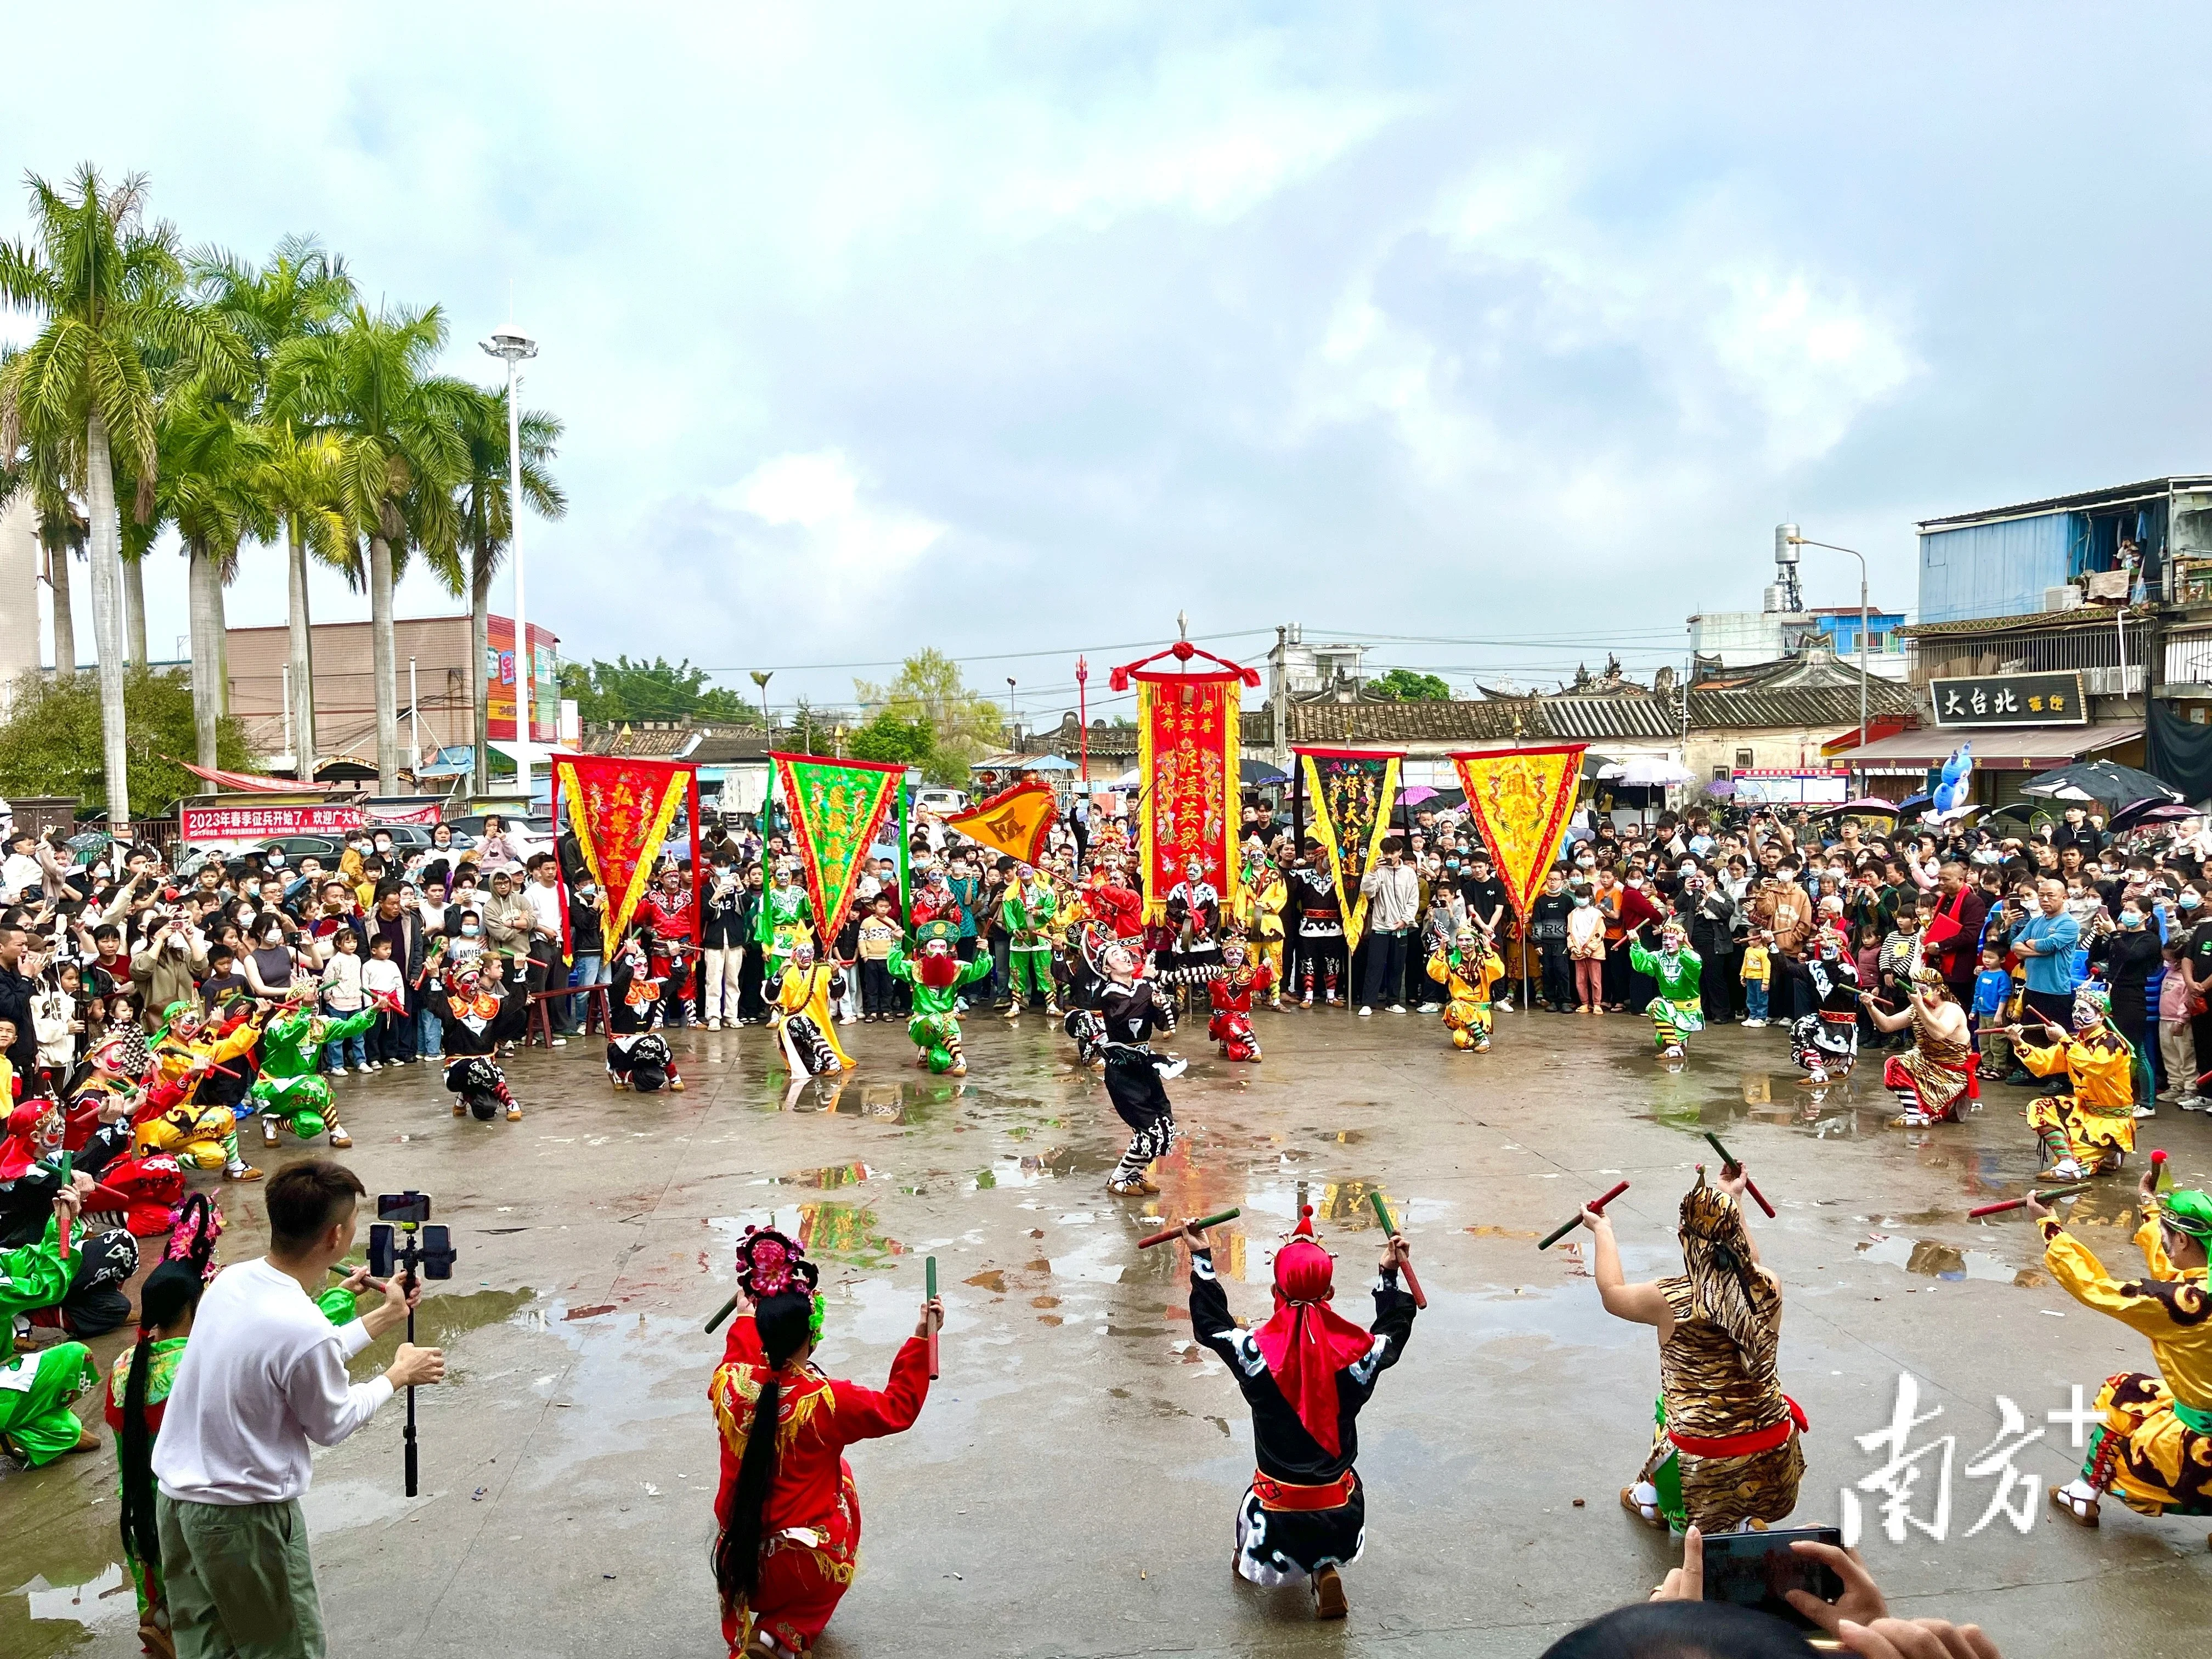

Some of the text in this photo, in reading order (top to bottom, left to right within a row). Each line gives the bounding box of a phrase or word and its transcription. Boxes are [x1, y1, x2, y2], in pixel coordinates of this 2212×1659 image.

[1945, 687, 2064, 715] 大台北 茶饮
[1342, 776, 1363, 877] 替天行道
